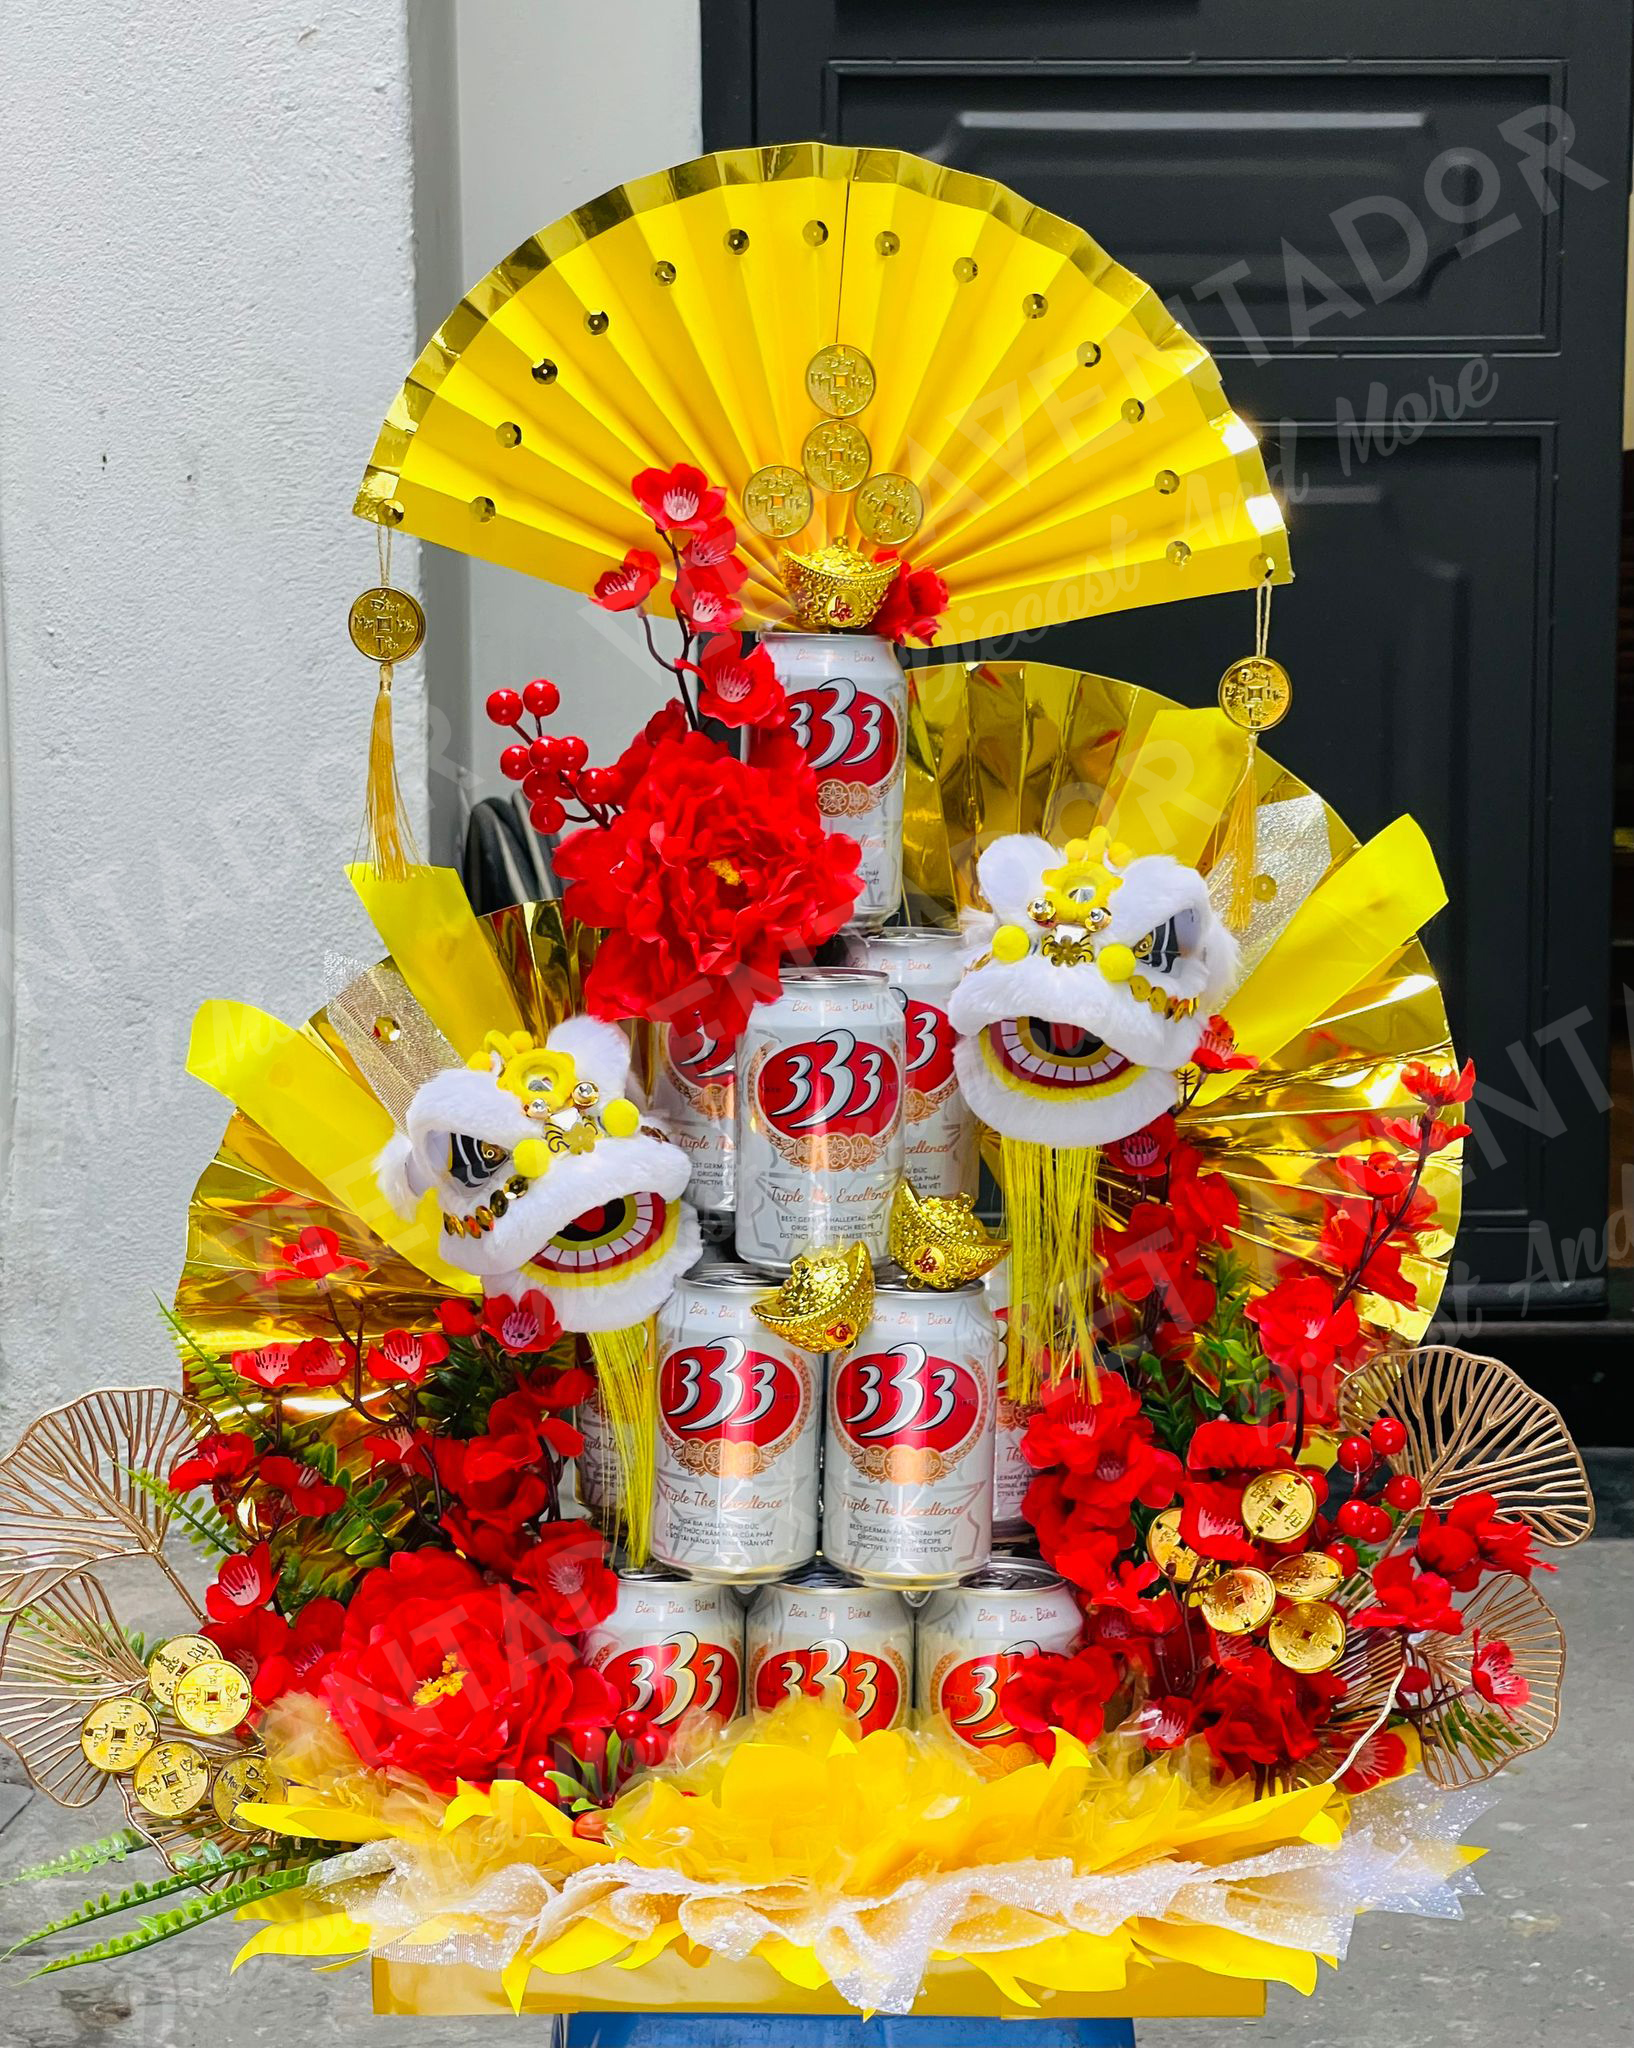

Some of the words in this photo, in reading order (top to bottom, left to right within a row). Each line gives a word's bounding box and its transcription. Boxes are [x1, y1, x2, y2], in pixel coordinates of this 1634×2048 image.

[788, 677, 883, 770] 333
[852, 1000, 875, 1012] Bière
[771, 1028, 883, 1129] 333
[771, 1185, 804, 1206] Triple
[927, 1311, 953, 1326] Bière
[667, 1336, 777, 1430] 333
[844, 1343, 957, 1437] 333
[664, 1484, 689, 1505] Triple
[694, 1490, 717, 1508] The
[842, 1492, 871, 1514] Triple
[875, 1498, 897, 1516] The
[889, 1537, 917, 1545] FRECH
[918, 1537, 941, 1545] RECIPE
[934, 1528, 952, 1536] HOPS
[885, 1545, 927, 1554] VIETAMESE
[930, 1545, 953, 1553] TOUCH
[667, 1600, 686, 1614] Bia
[695, 1598, 716, 1613] Bière
[788, 1603, 808, 1618] Bier
[818, 1606, 836, 1620] Bi
[847, 1606, 872, 1620] Bière
[1009, 1609, 1027, 1623] Bia
[1036, 1607, 1057, 1621] Bière
[624, 1631, 723, 1727] 333
[780, 1638, 878, 1720] 333
